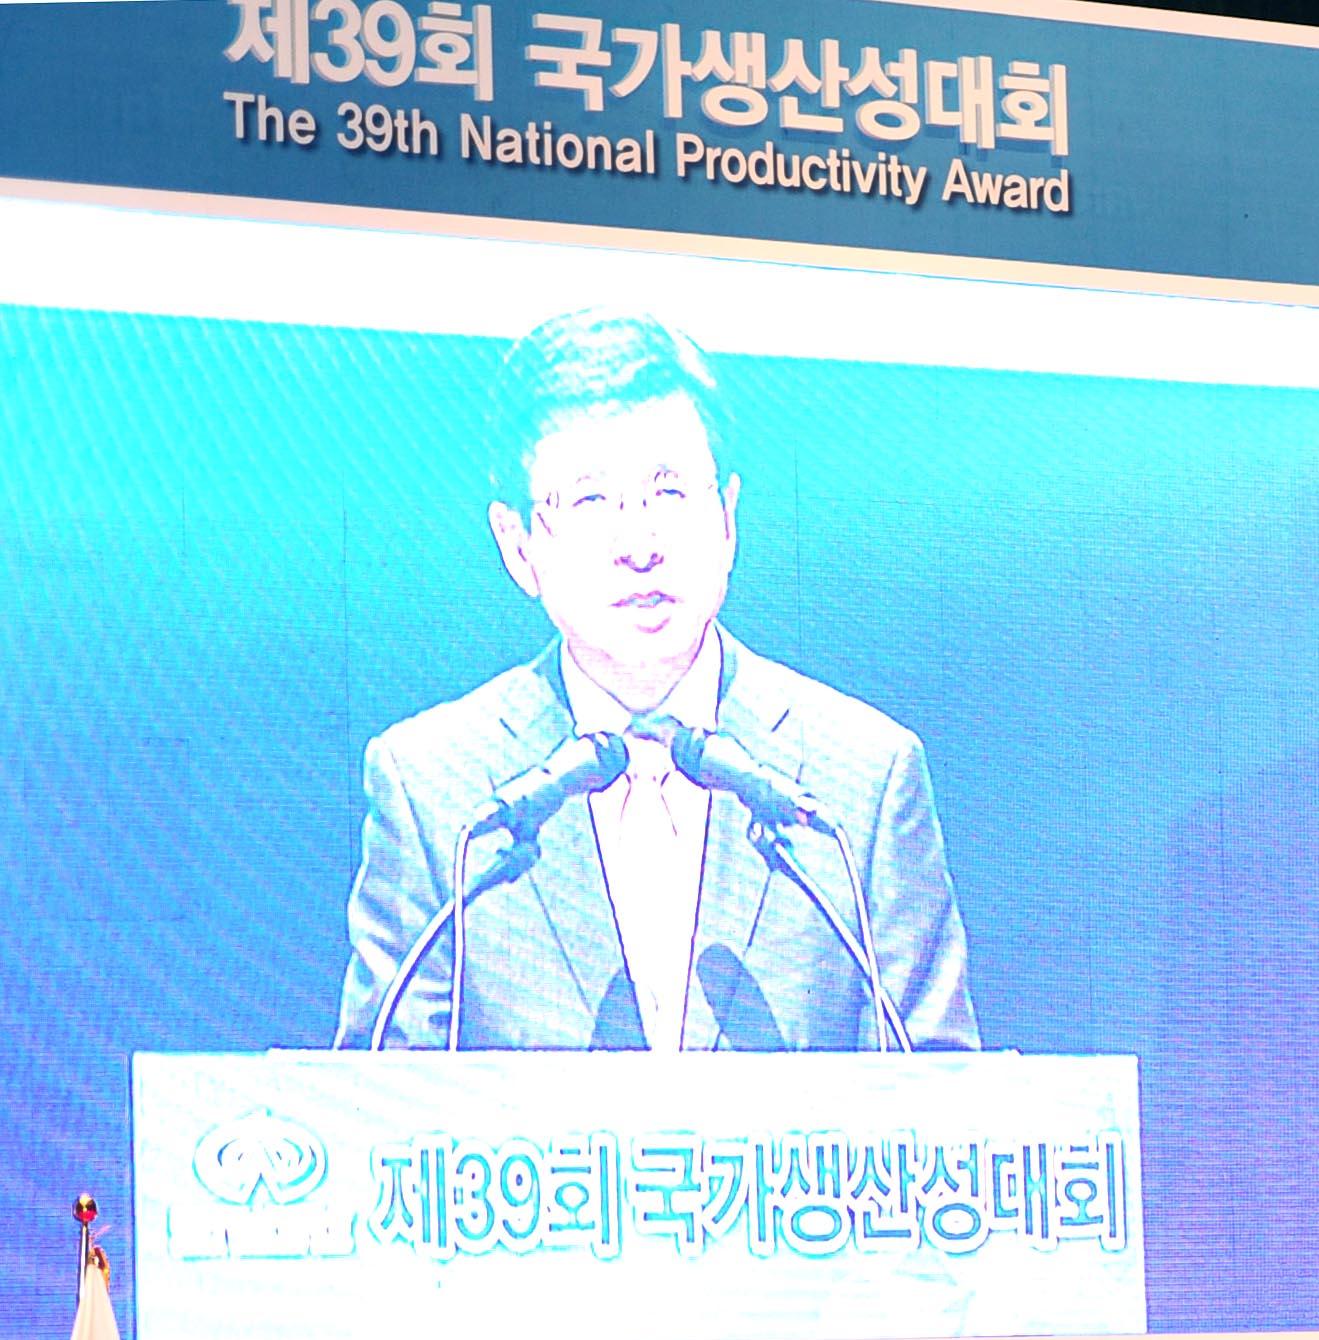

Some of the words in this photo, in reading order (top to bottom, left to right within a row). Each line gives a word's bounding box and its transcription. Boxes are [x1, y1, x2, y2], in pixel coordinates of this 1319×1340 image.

[224, 0, 493, 100] 제39회
[525, 13, 1068, 156] 국가생산성대회
[223, 92, 317, 146] The
[337, 101, 438, 156] 39th
[461, 114, 657, 175] National
[677, 132, 927, 206] Productivity
[941, 158, 1070, 213] Award
[376, 1131, 617, 1253] 제39회
[628, 1131, 1126, 1253] 국가생산성대회
